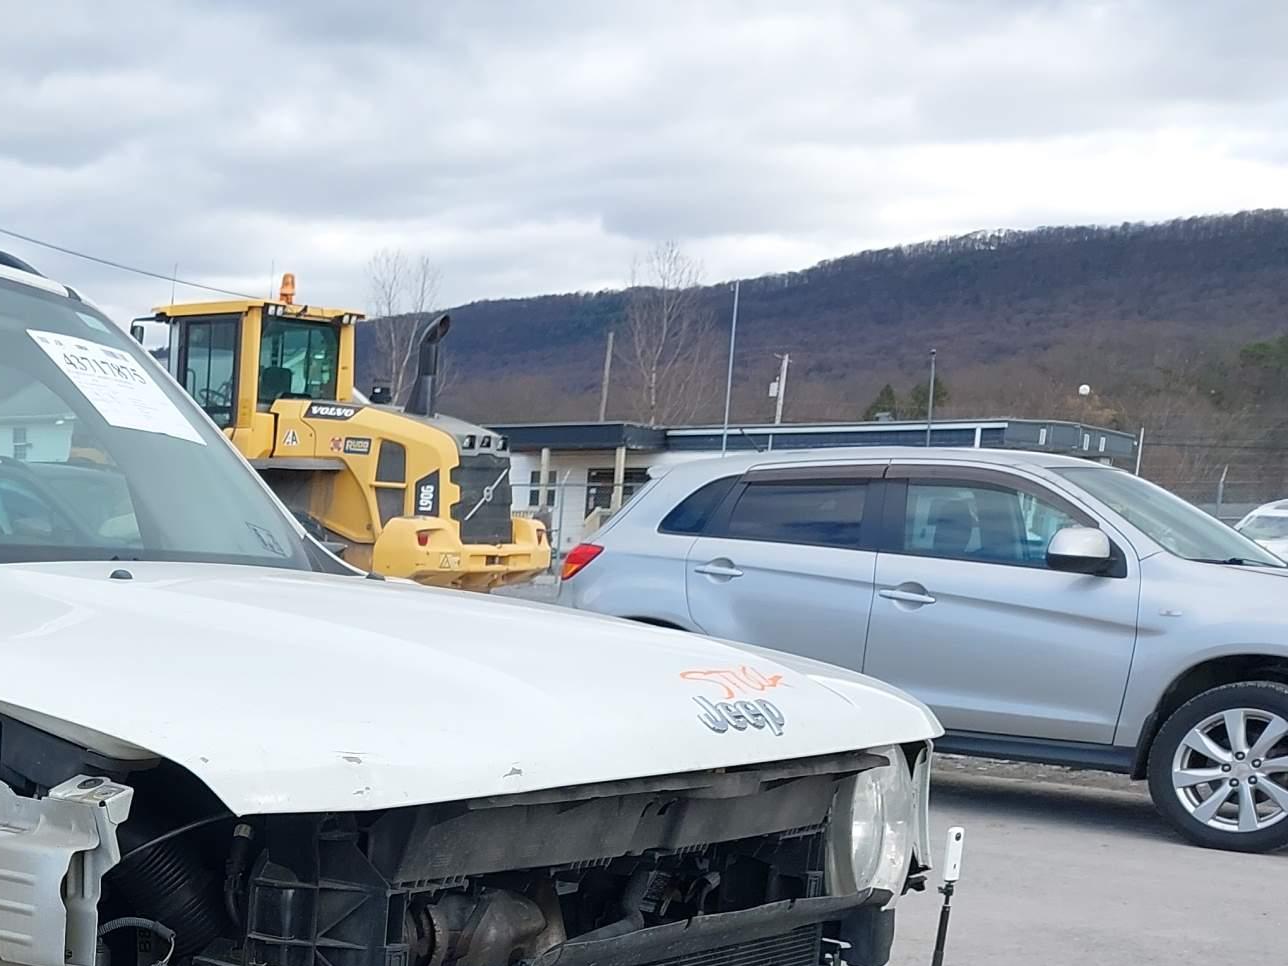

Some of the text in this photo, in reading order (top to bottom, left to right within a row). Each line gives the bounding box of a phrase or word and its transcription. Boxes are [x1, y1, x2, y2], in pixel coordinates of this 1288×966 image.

[63, 353, 147, 385] 43717875
[311, 405, 355, 418] VOLVO
[418, 484, 435, 512] L90G
[692, 695, 785, 737] Jeep
